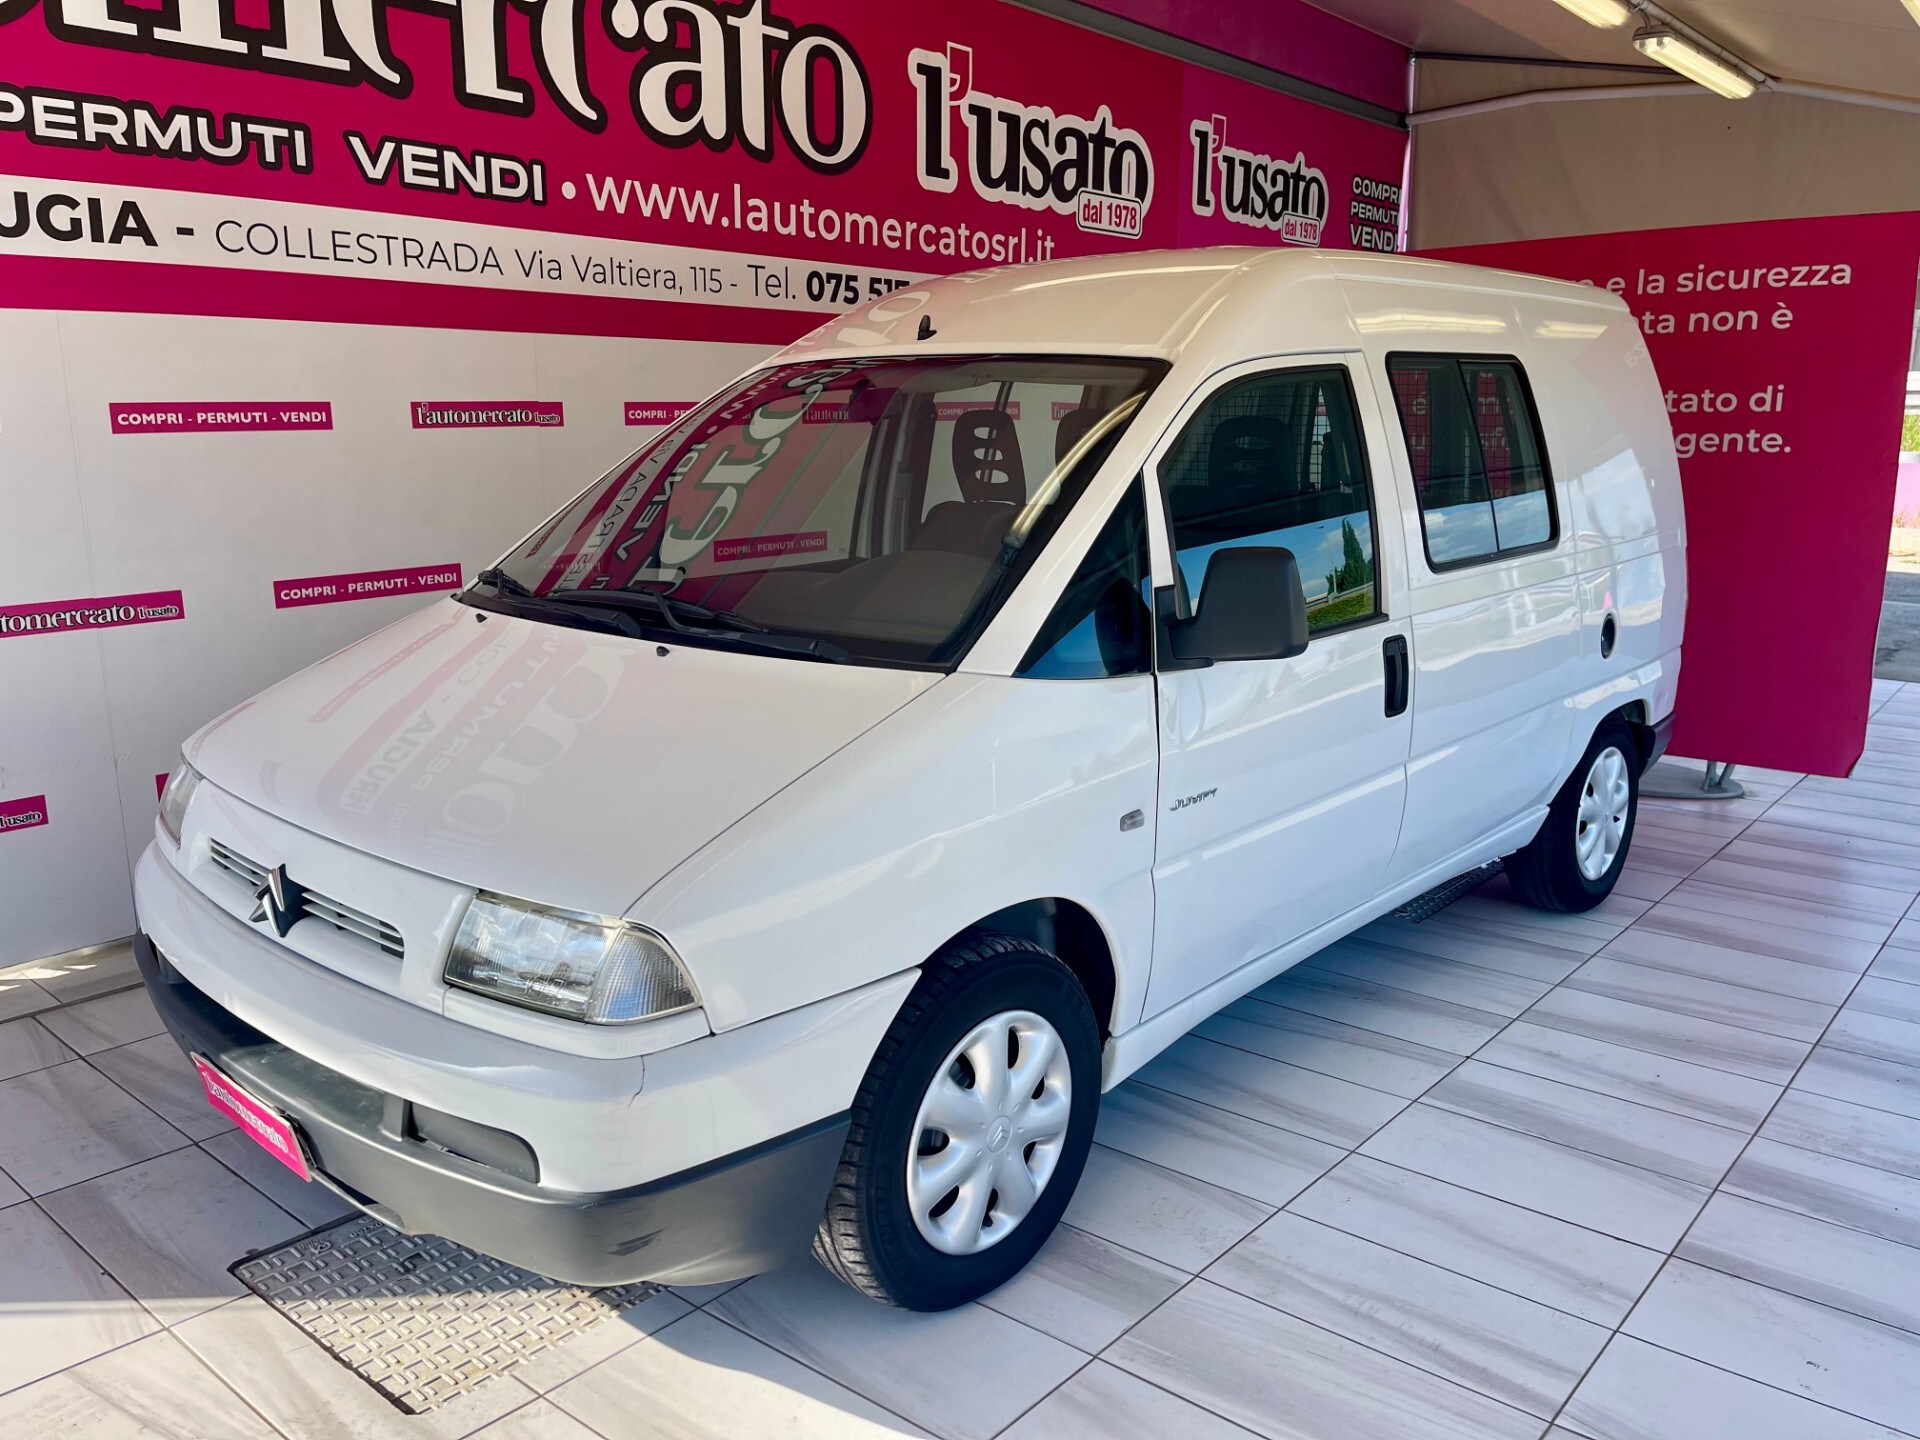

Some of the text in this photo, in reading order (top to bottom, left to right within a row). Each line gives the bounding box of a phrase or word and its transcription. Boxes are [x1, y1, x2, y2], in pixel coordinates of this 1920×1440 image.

[348, 136, 545, 202] VENDI
[586, 173, 1056, 264] www.lautomercatosrl.it
[1083, 199, 1137, 230] dal 1978
[1284, 219, 1318, 241] dal 1978
[215, 220, 504, 276] COLLESTRADA
[515, 248, 562, 282] Via
[571, 256, 684, 295] Valtiera,
[689, 266, 723, 293] 115
[747, 264, 797, 300] Tel.
[806, 270, 860, 305] 075
[1606, 263, 1852, 295] e la sicurezza
[1688, 309, 1758, 333] non
[1771, 302, 1793, 330] è
[1749, 385, 1785, 412] di
[117, 412, 183, 425] COMPRI
[197, 411, 268, 424] PERMUTI
[280, 411, 327, 423] VENDI
[415, 402, 533, 425] l'automercato
[628, 409, 667, 419] COMPRI
[717, 538, 825, 556] COMPRI PERMUTI VENDI
[280, 585, 337, 600] COMPRI
[348, 577, 408, 593] PERMUTI
[418, 572, 457, 586] VENDI
